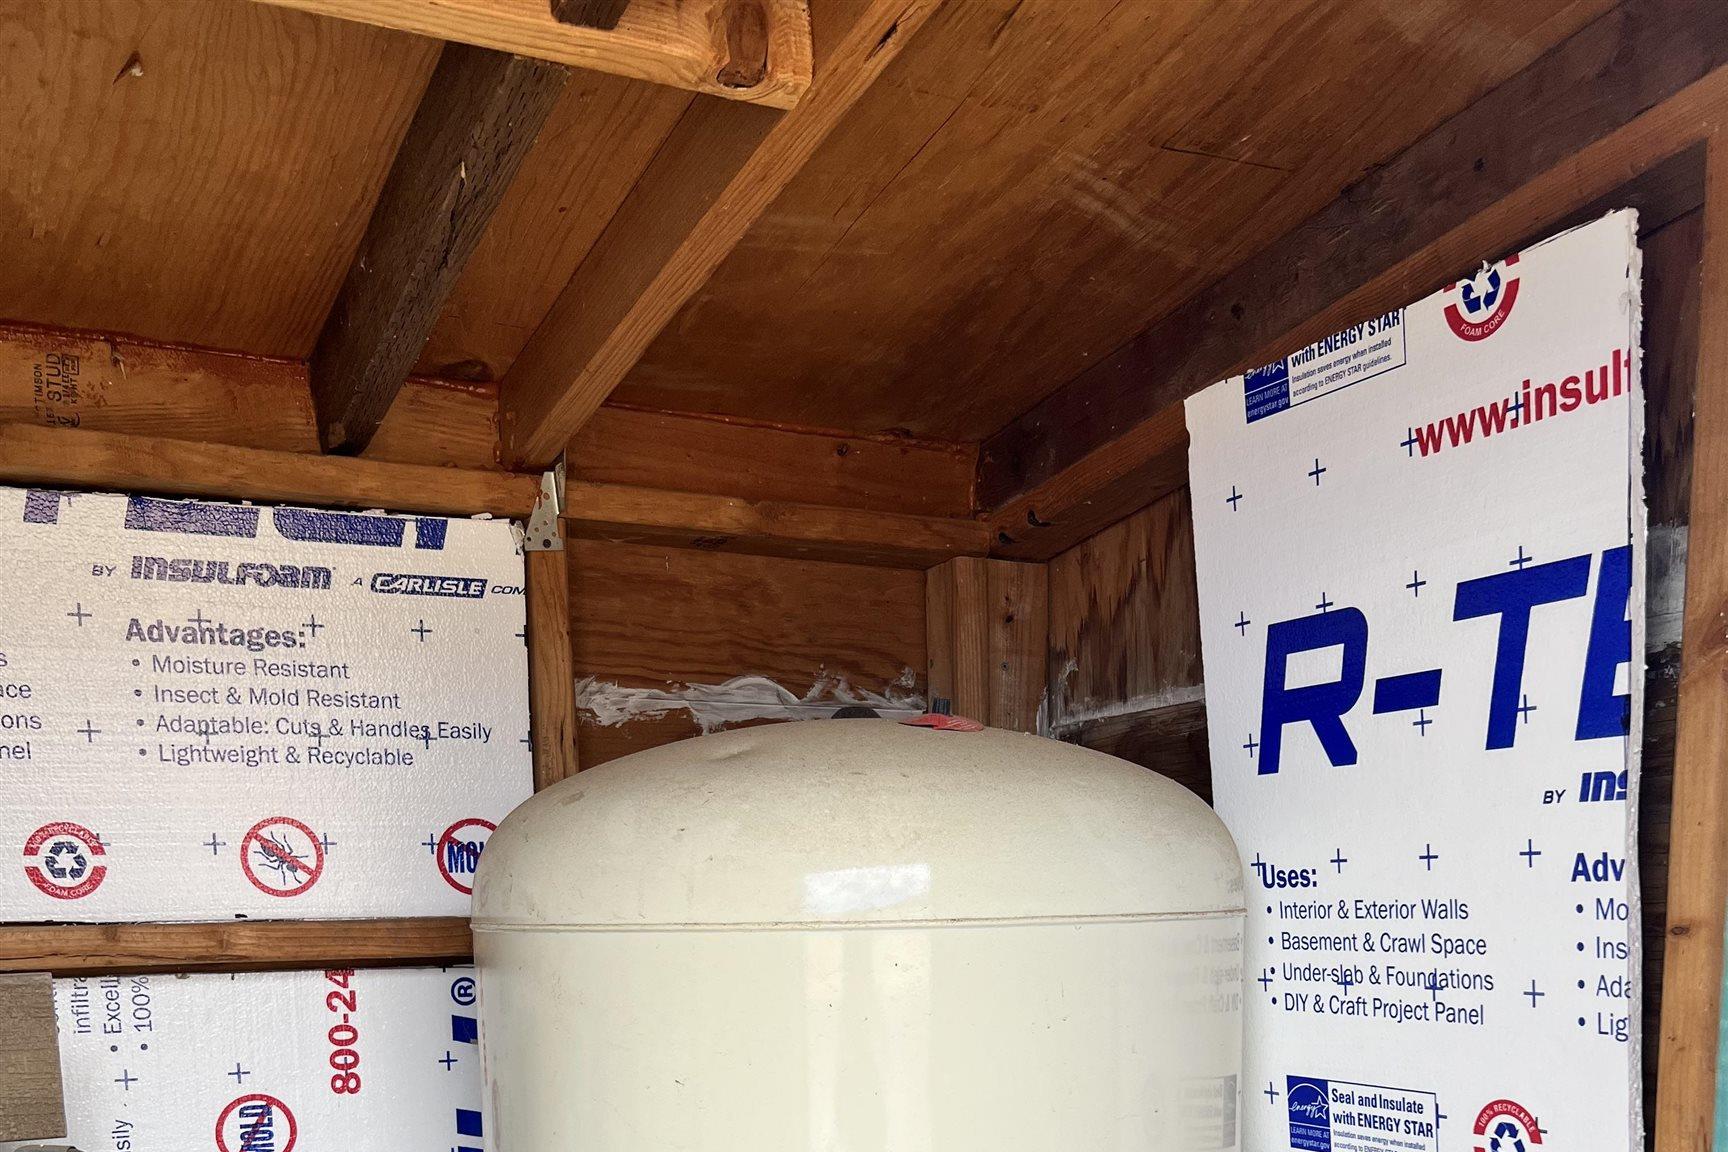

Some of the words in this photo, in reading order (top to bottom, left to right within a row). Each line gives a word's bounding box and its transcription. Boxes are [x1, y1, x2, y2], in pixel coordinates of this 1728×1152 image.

[1460, 323, 1483, 337] FOAM
[1483, 309, 1505, 334] CORE
[1291, 344, 1316, 368] with
[1317, 324, 1364, 358] ENERGY
[1368, 310, 1400, 336] STAR
[1292, 366, 1317, 384] Insulation
[1317, 364, 1332, 377] saves
[1333, 357, 1351, 372] energy
[1352, 349, 1367, 360] when
[1368, 338, 1392, 353] installed
[46, 353, 61, 402] STUD
[1292, 381, 1318, 397] according
[1324, 370, 1346, 385] ENERGY
[1347, 364, 1362, 376] STAR
[1246, 393, 1264, 406] LEARN
[1265, 387, 1280, 399] MORE
[1247, 397, 1289, 418] energystar.gov
[92, 565, 116, 577] BY
[350, 577, 363, 587] A
[374, 575, 485, 597] CARLISLE
[125, 617, 306, 652] Advantages:
[152, 655, 246, 676] Moisture
[253, 658, 350, 680] Resistant
[154, 684, 220, 705] Insect
[226, 687, 242, 705] &
[249, 687, 299, 707] Mold
[307, 689, 401, 710] Resistant
[156, 715, 269, 739] Adaptable:
[276, 717, 322, 737] Cuts
[329, 719, 344, 737] &
[350, 720, 431, 740] Handles
[438, 722, 492, 743] Easily
[158, 744, 278, 767] Lightweight
[286, 746, 301, 765] &
[308, 747, 414, 769] Recyclable
[1543, 789, 1566, 804] BY
[44, 883, 68, 896] FOAM
[70, 882, 93, 896] CORE
[1262, 864, 1318, 889] Uses:
[1280, 900, 1333, 920] Interior
[1337, 900, 1350, 919] &
[1354, 899, 1417, 919] Exterior
[1420, 899, 1469, 920] Walls
[1281, 931, 1358, 951] Basement
[1363, 932, 1375, 952] &
[1380, 932, 1426, 953] Crawl
[1430, 933, 1487, 959] Space
[1283, 962, 1364, 985] Under-slab
[1369, 965, 1381, 985] &
[1386, 965, 1494, 991] Foundations
[131, 976, 153, 1032] 100%
[1284, 993, 1308, 1012] DIY
[1313, 994, 1325, 1014] &
[1329, 994, 1369, 1017] Craft
[1373, 998, 1430, 1024] Project
[1435, 1001, 1484, 1025] Panel
[1331, 1088, 1355, 1105] Seal
[1357, 1093, 1378, 1108] and
[1379, 1094, 1424, 1115] Insulate
[1333, 1111, 1356, 1126] with
[1357, 1113, 1401, 1133] ENERGY
[1404, 1119, 1434, 1138] STAR
[1478, 1108, 1494, 1127] 100%
[1493, 1103, 1536, 1133] RECYCLABLE
[1291, 1126, 1307, 1136] LEARN
[1307, 1129, 1323, 1138] MORE
[1291, 1138, 1330, 1151] energystar.gov
